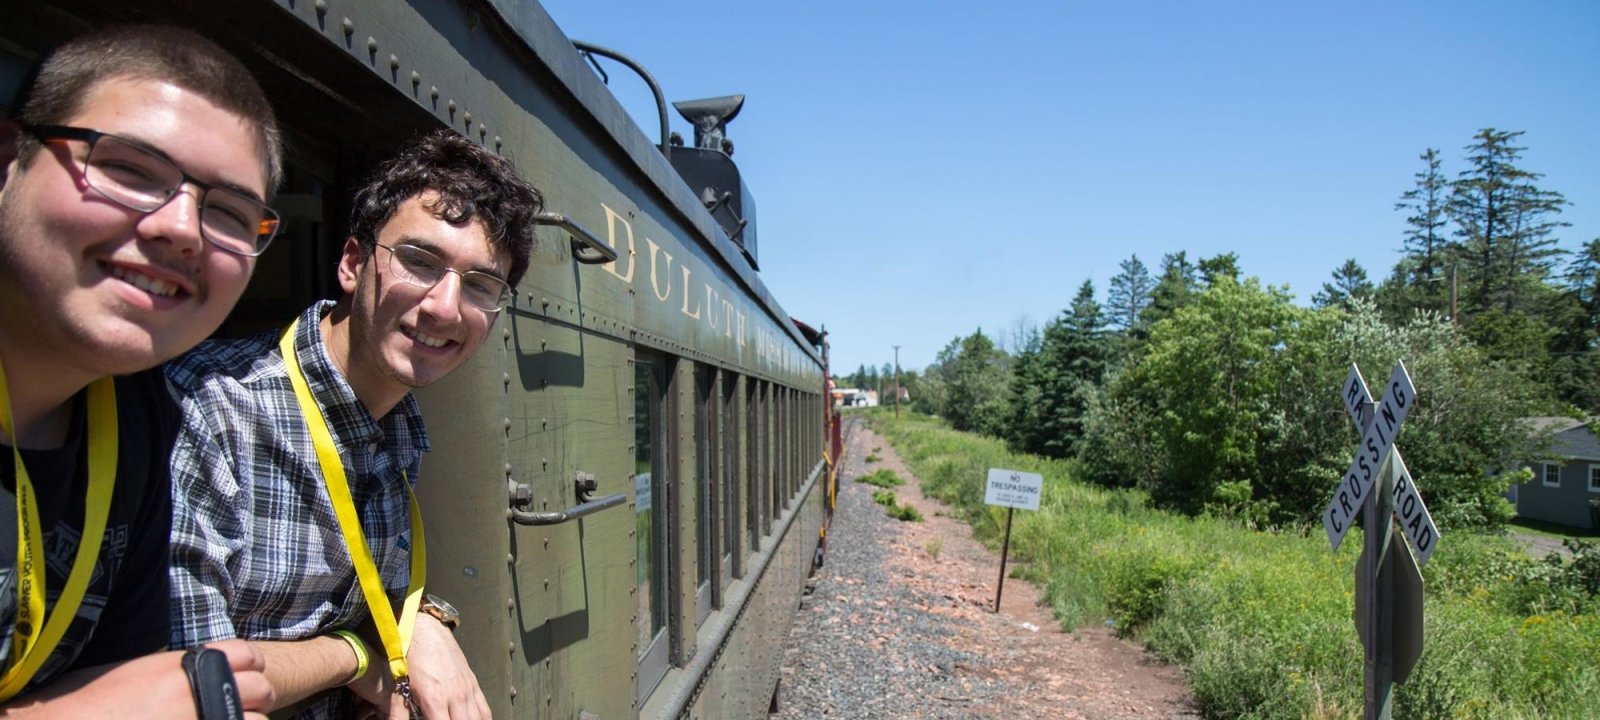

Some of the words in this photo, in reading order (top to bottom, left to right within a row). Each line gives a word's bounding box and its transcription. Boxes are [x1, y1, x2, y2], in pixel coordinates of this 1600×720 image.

[601, 202, 746, 346] DULUTH
[991, 481, 1038, 494] TRESPASSING
[1010, 475, 1020, 483] NO
[1330, 381, 1405, 533] CROSSING
[1347, 378, 1365, 426] RA
[1393, 474, 1431, 552] ROAD
